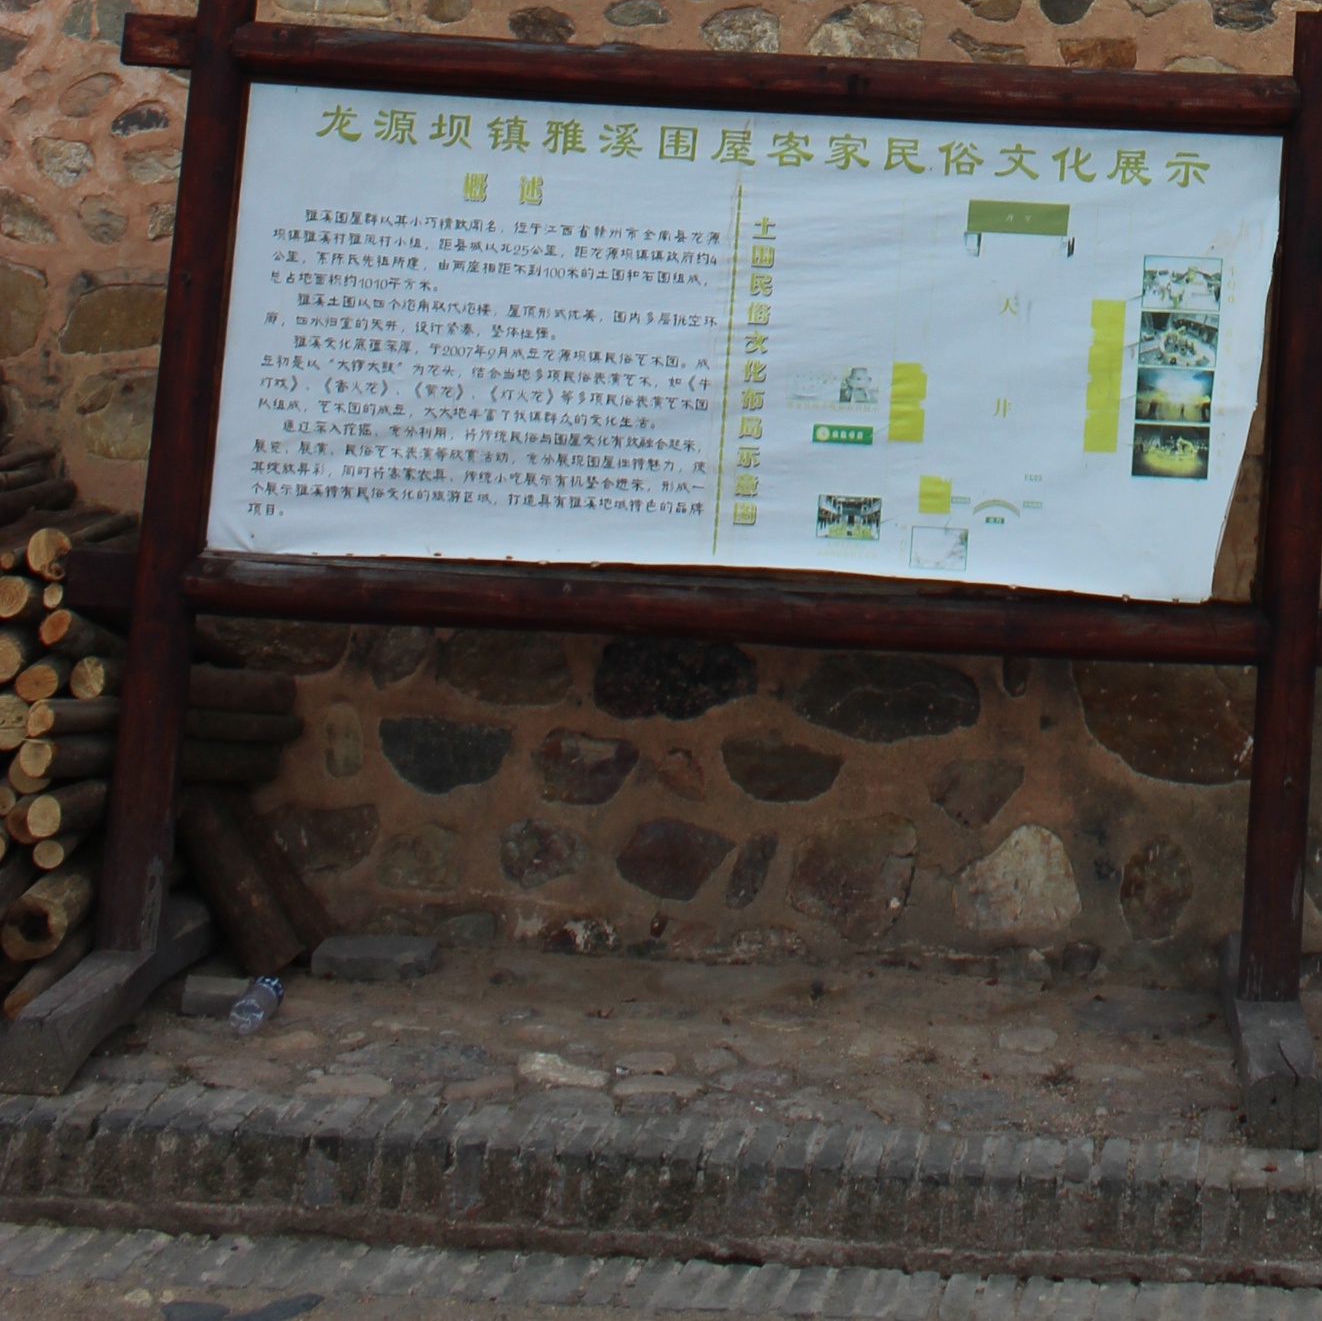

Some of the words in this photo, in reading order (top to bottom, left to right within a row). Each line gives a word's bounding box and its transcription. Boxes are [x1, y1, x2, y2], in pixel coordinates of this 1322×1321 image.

[315, 104, 1211, 187] 龙源坝镇雅溪围屋客家民俗文化展示
[462, 172, 544, 205] 概述
[733, 216, 777, 526] 土围民俗文化布局示意图
